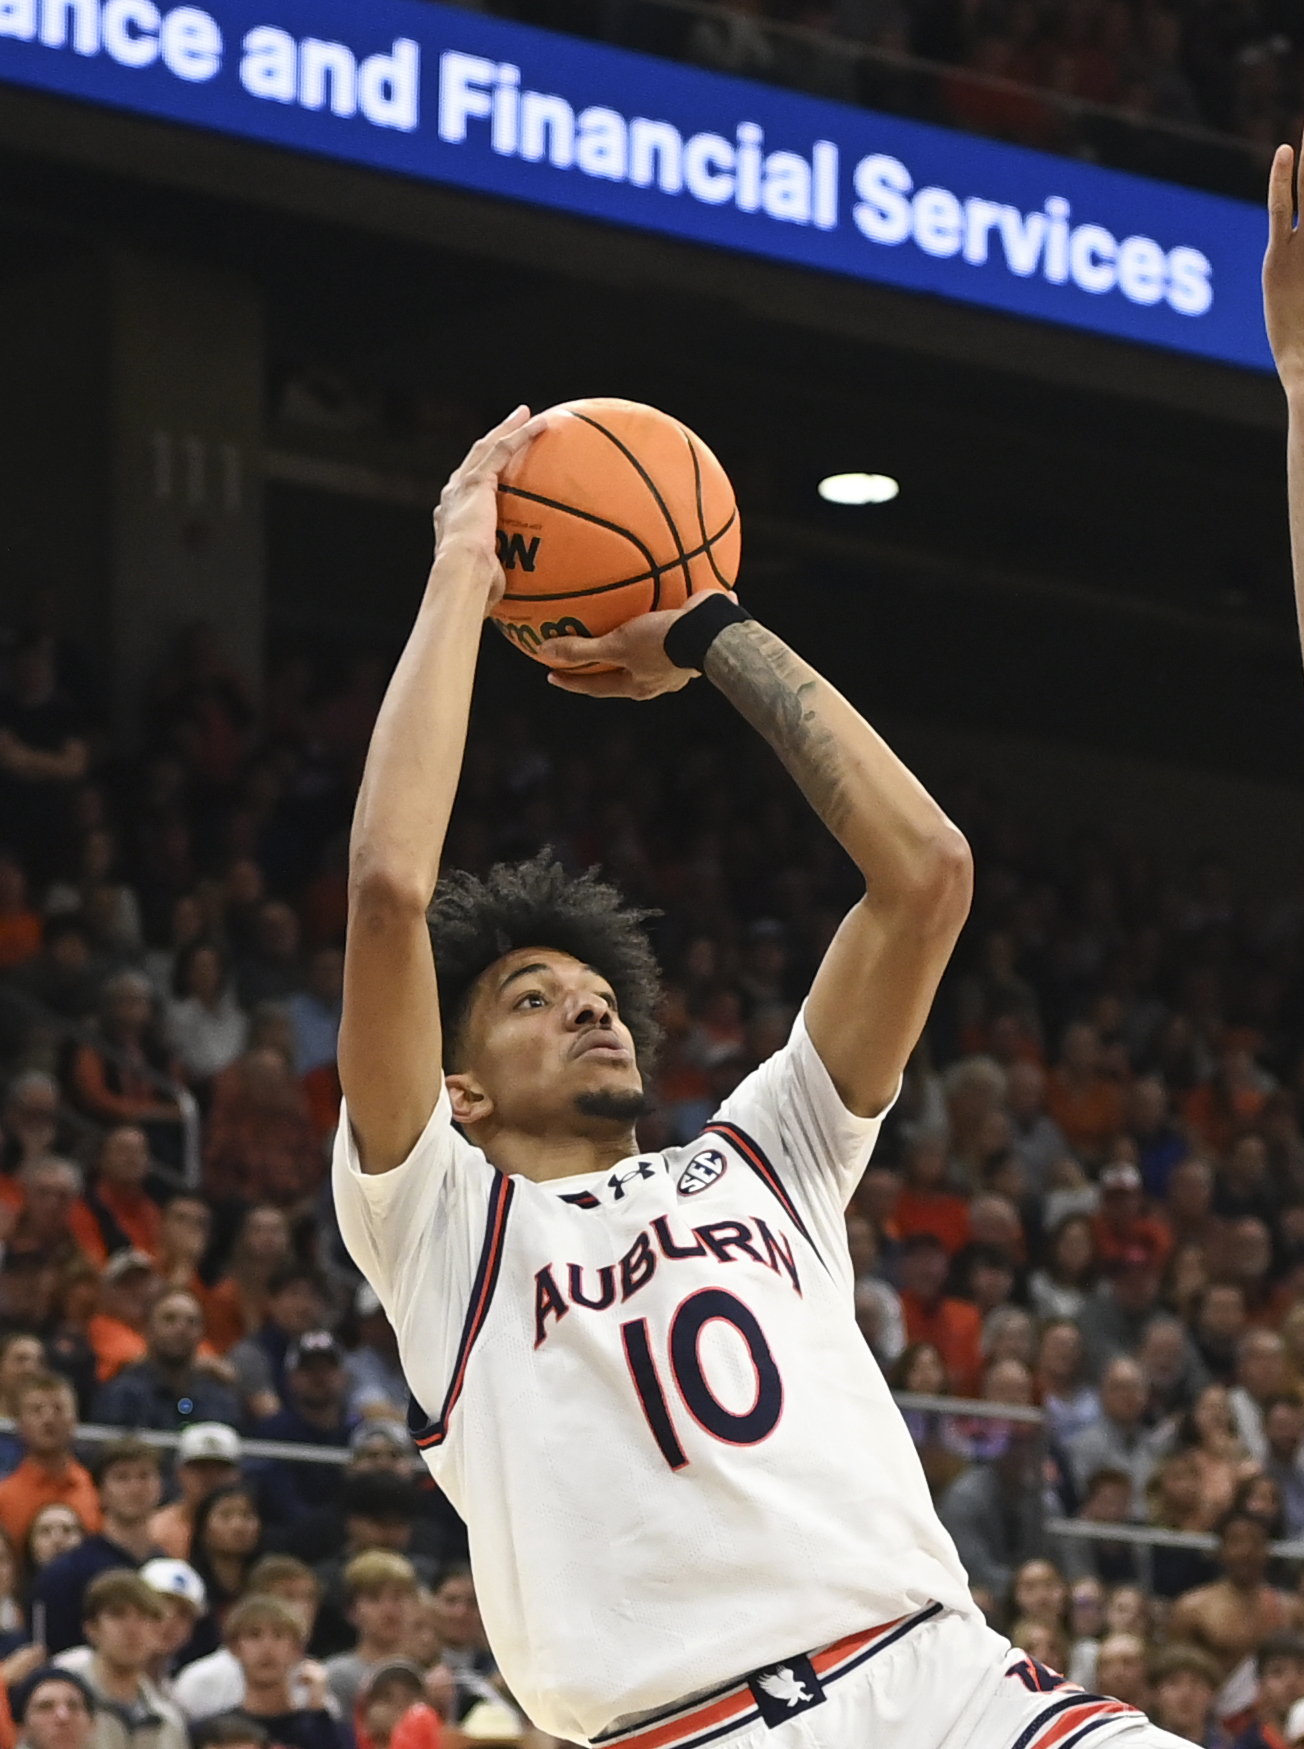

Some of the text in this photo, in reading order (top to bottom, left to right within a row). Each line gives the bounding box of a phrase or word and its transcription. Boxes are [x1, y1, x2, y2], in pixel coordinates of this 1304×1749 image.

[239, 24, 420, 133] and
[438, 50, 839, 230] Financial
[853, 153, 1213, 317] Services
[679, 1150, 725, 1195] SEC
[533, 1213, 803, 1351] AUBURN
[619, 1285, 785, 1473] 10
